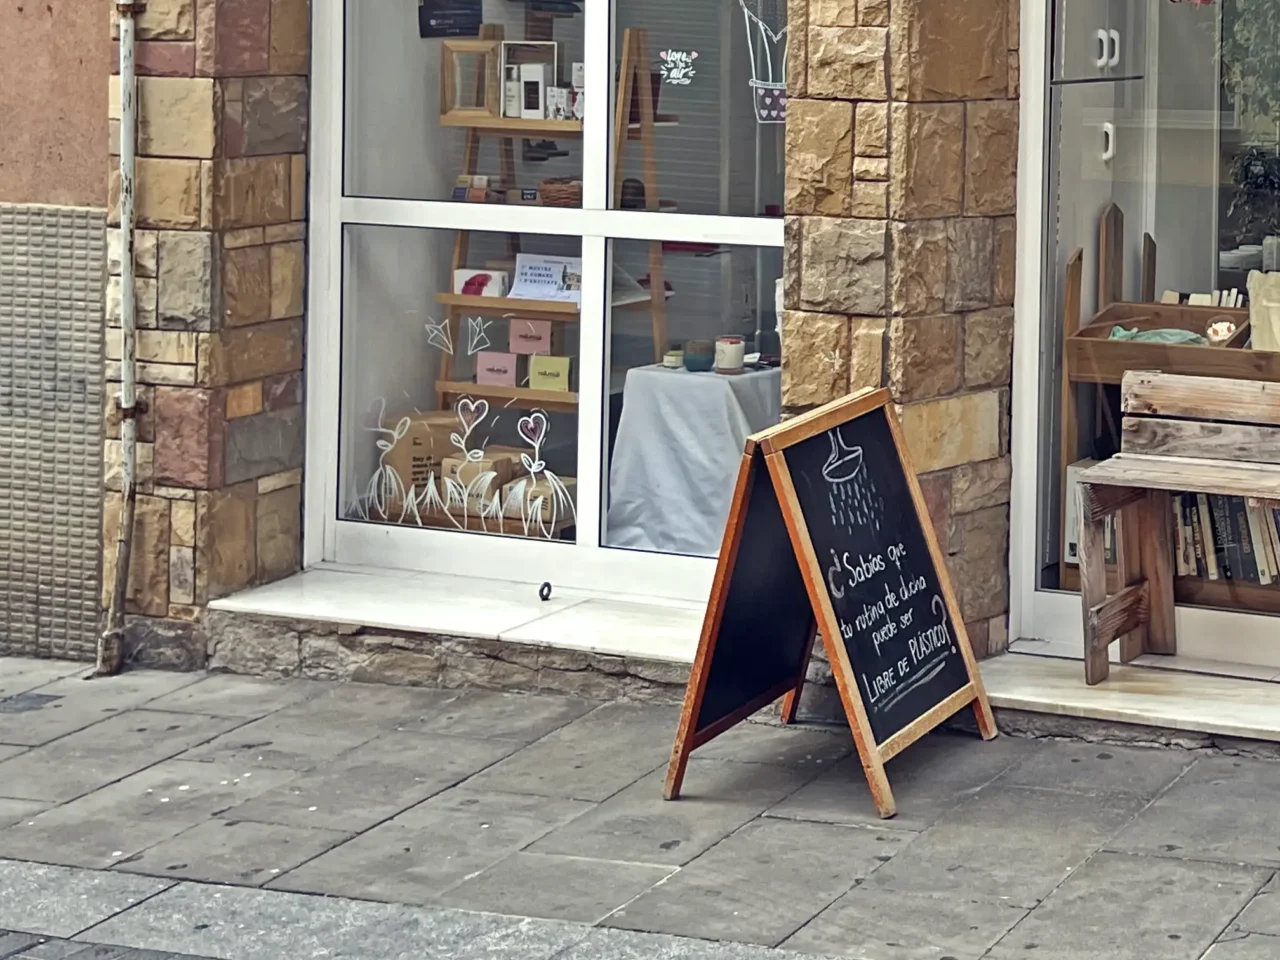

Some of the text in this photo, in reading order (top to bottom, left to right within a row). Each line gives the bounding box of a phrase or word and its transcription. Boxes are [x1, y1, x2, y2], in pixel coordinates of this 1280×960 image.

[887, 543, 907, 571] que
[841, 574, 927, 639] tu rutina de ducha
[872, 608, 913, 656] puede ser
[898, 657, 910, 677] DE
